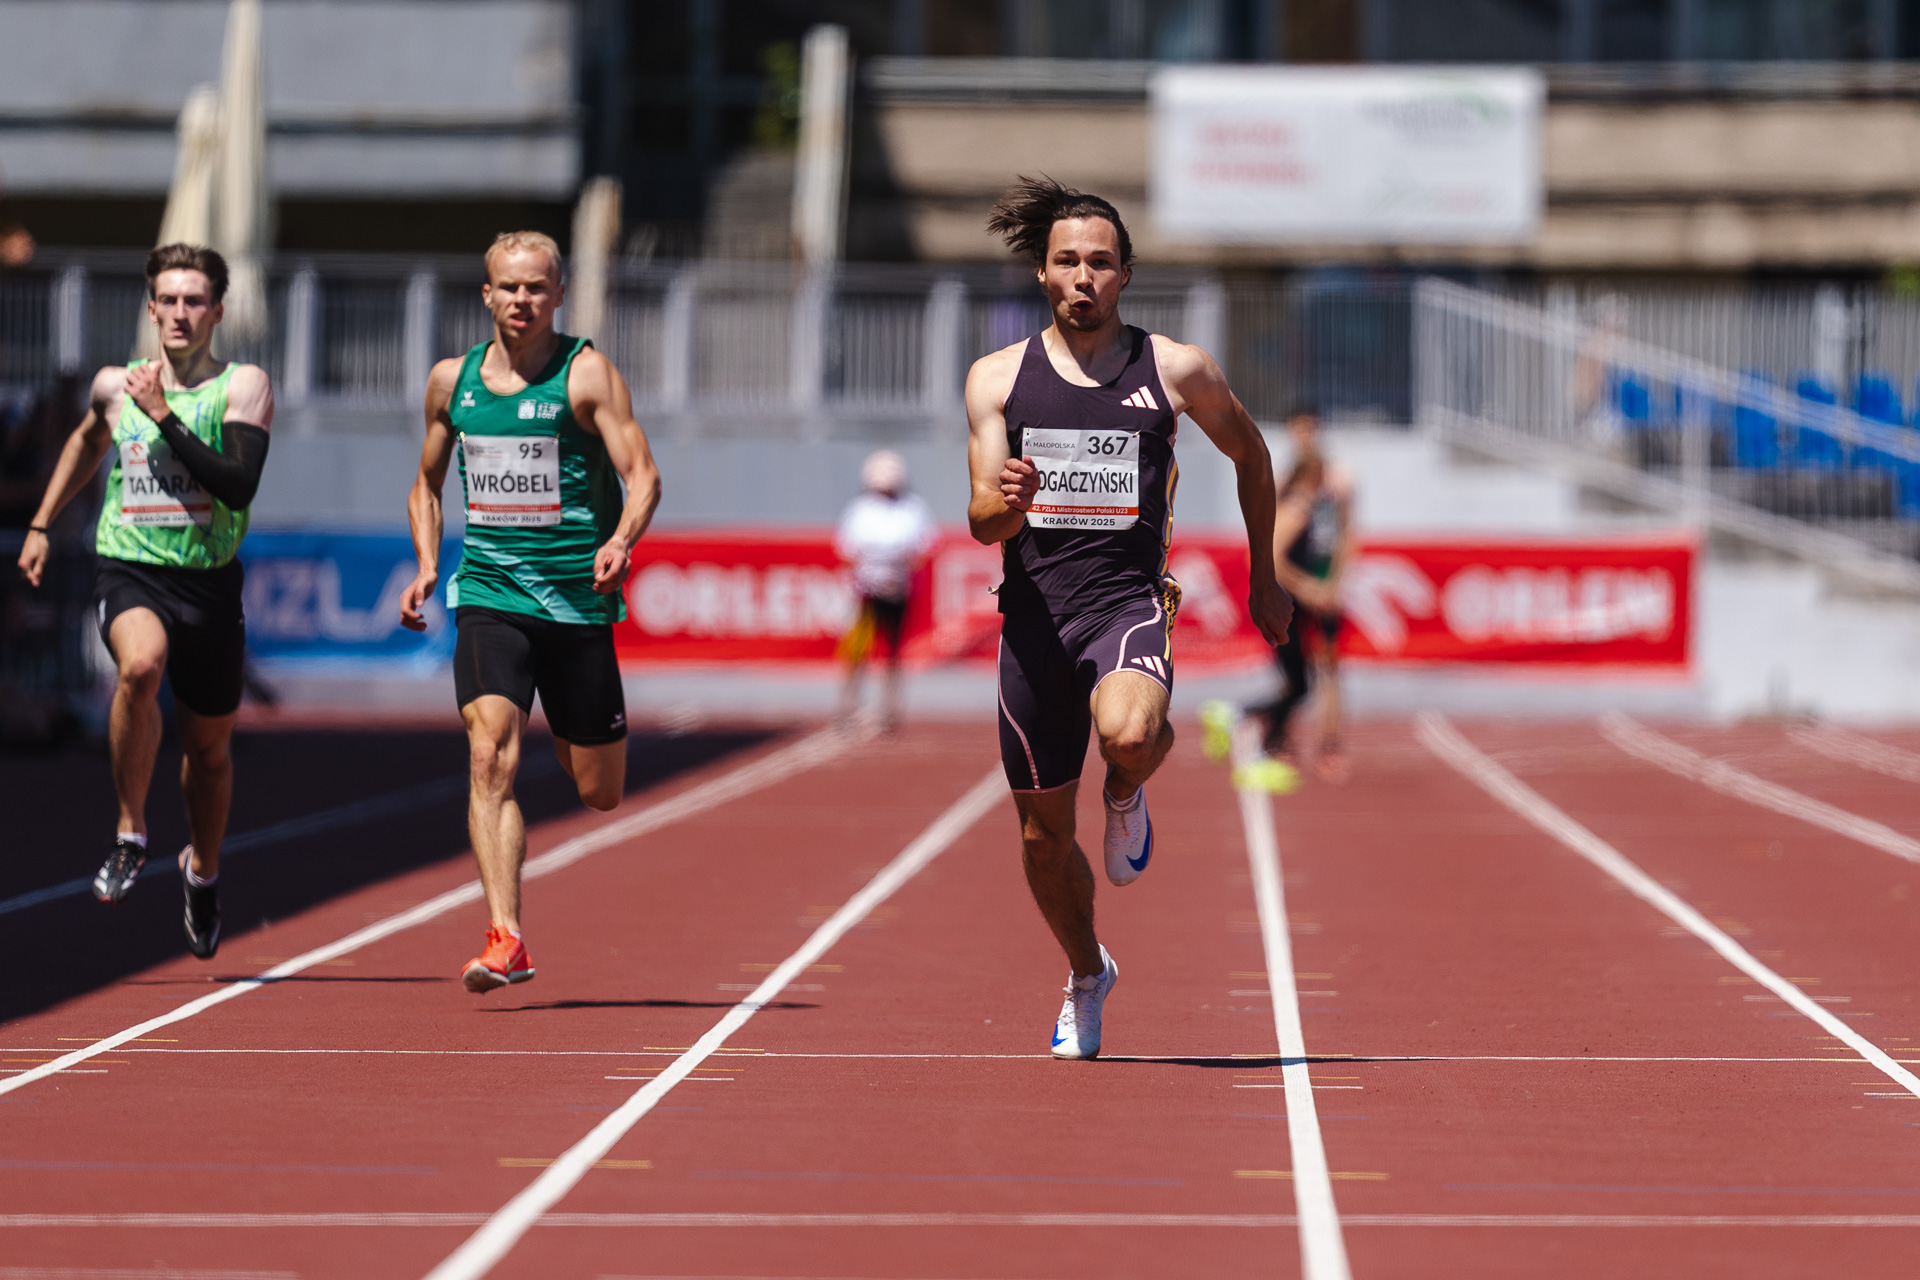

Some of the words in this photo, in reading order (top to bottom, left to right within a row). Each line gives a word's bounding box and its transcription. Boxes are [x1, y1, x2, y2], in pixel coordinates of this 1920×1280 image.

[519, 443, 543, 460] 95
[1087, 436, 1129, 456] 367
[471, 470, 554, 493] WRÓBEL
[1038, 467, 1133, 494] OGACZYŃSKI
[1042, 516, 1088, 526] KRAKÓW
[1091, 518, 1115, 526] 2025
[1057, 506, 1095, 514] Mistrzostwa
[1096, 507, 1115, 515] Polski
[630, 561, 860, 638] ORLEN
[1442, 564, 1676, 642] ORLEN
